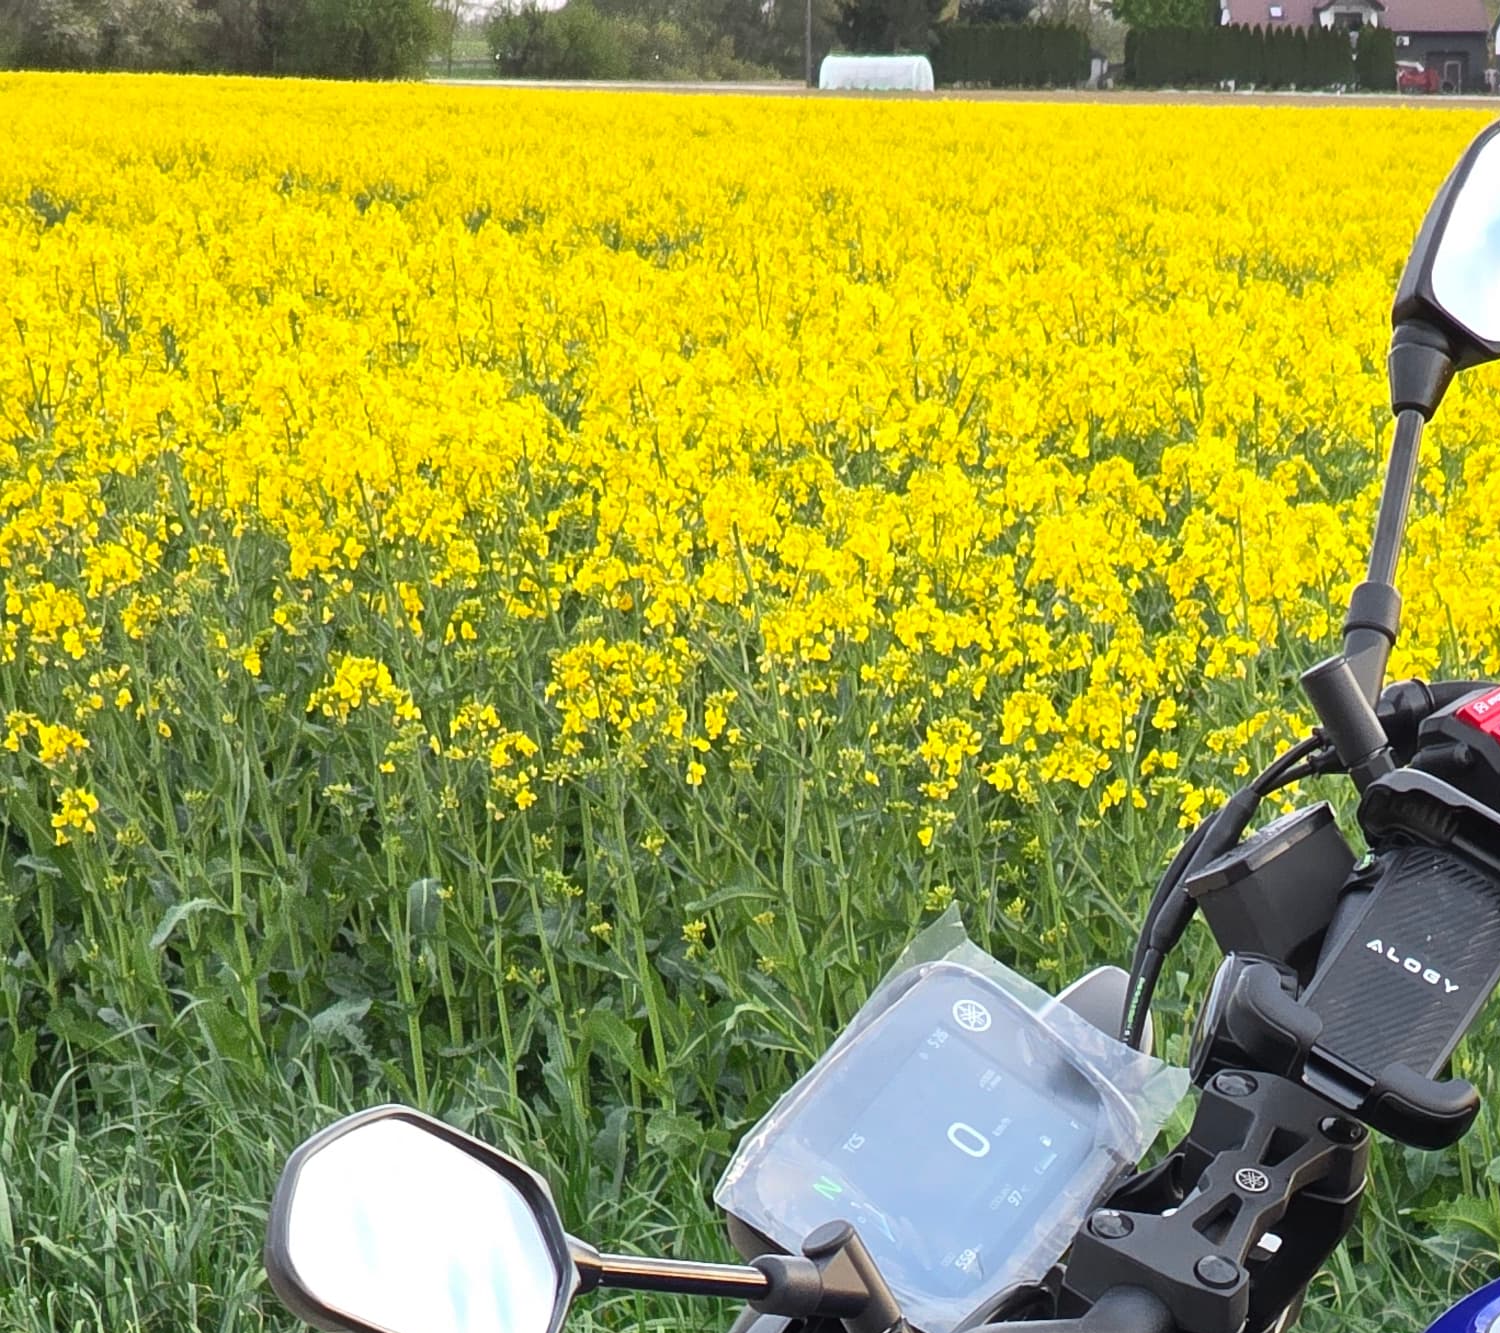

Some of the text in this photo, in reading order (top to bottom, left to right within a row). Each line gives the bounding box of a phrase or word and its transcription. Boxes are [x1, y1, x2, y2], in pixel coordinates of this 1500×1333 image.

[1366, 939, 1459, 993] ALOGY
[843, 1132, 865, 1153] TCS
[946, 1121, 991, 1158] 0
[812, 1174, 843, 1201] N
